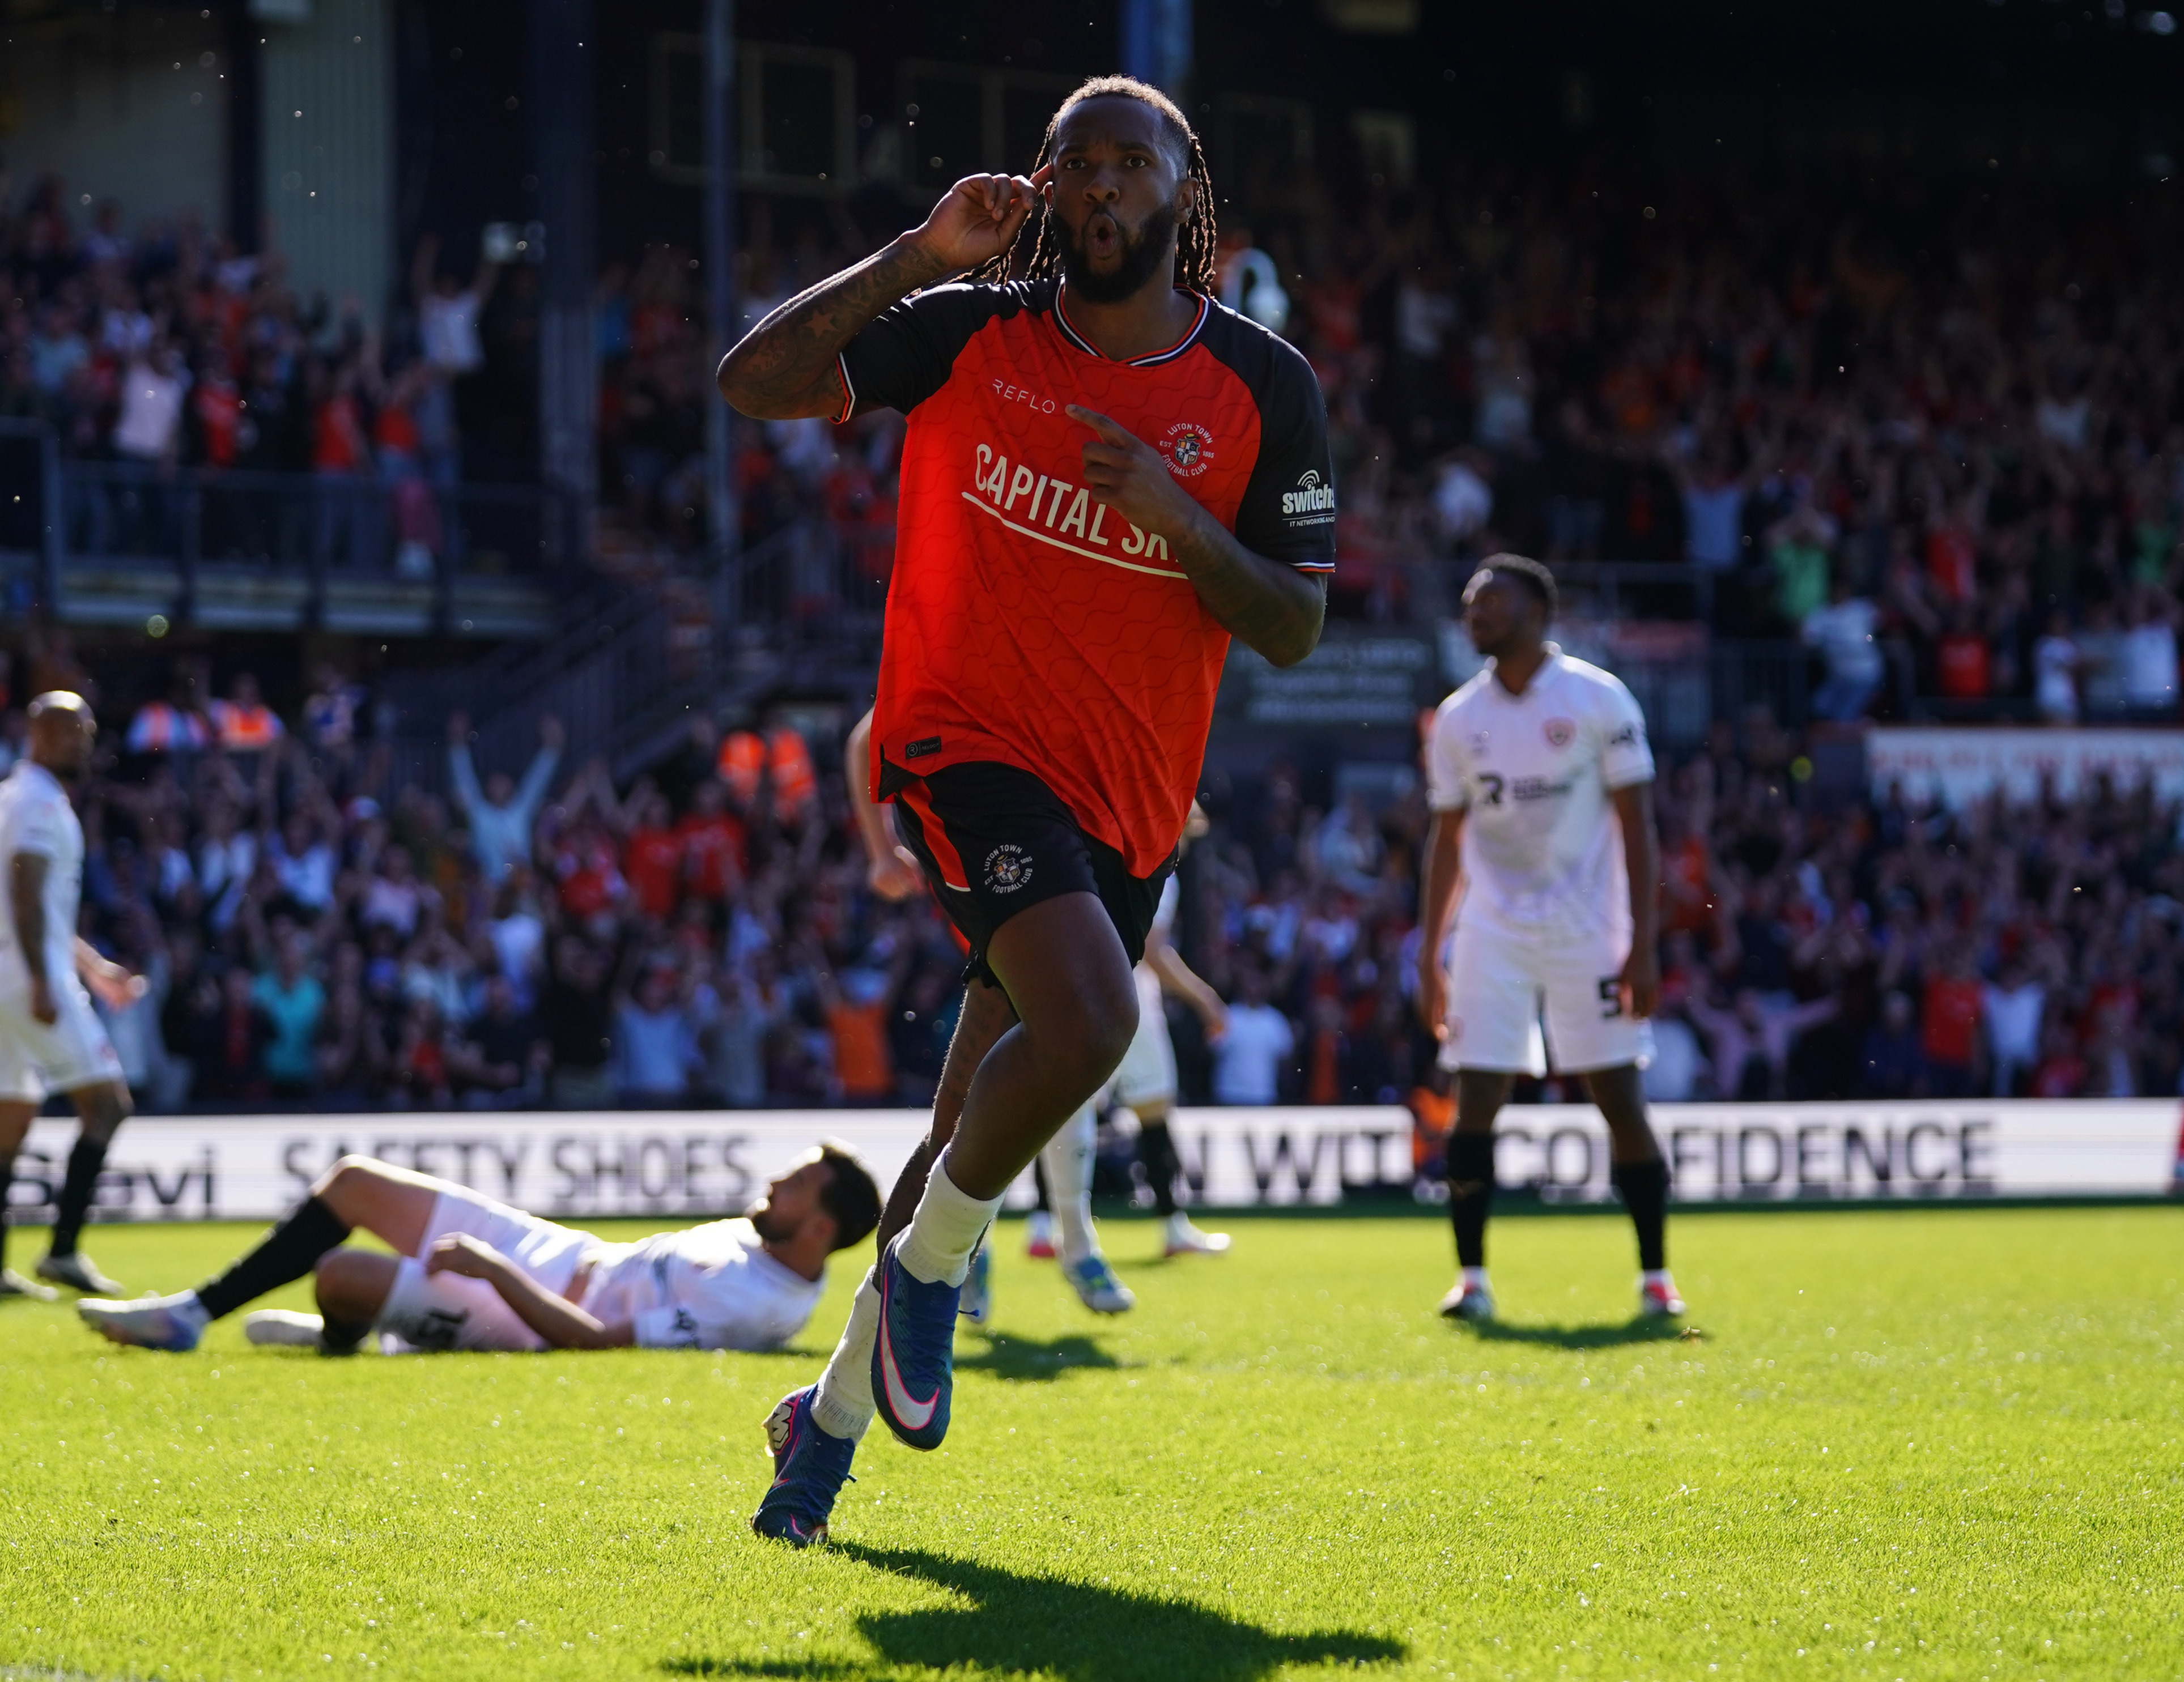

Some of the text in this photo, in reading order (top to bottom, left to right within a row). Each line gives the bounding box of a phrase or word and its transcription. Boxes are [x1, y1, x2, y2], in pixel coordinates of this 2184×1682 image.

[992, 378, 1055, 414] REFLO
[1167, 423, 1213, 444] LUTON TOWN
[1162, 454, 1207, 476] FOOTBALL CLUB
[975, 444, 1108, 546] CAPITAL
[984, 844, 1022, 871] LUTON TOWN
[984, 875, 994, 885] EST
[992, 868, 1033, 893] FOOTBALL CLUB
[550, 1138, 751, 1198] SHOES
[1492, 1122, 1992, 1187] COFIDENCE
